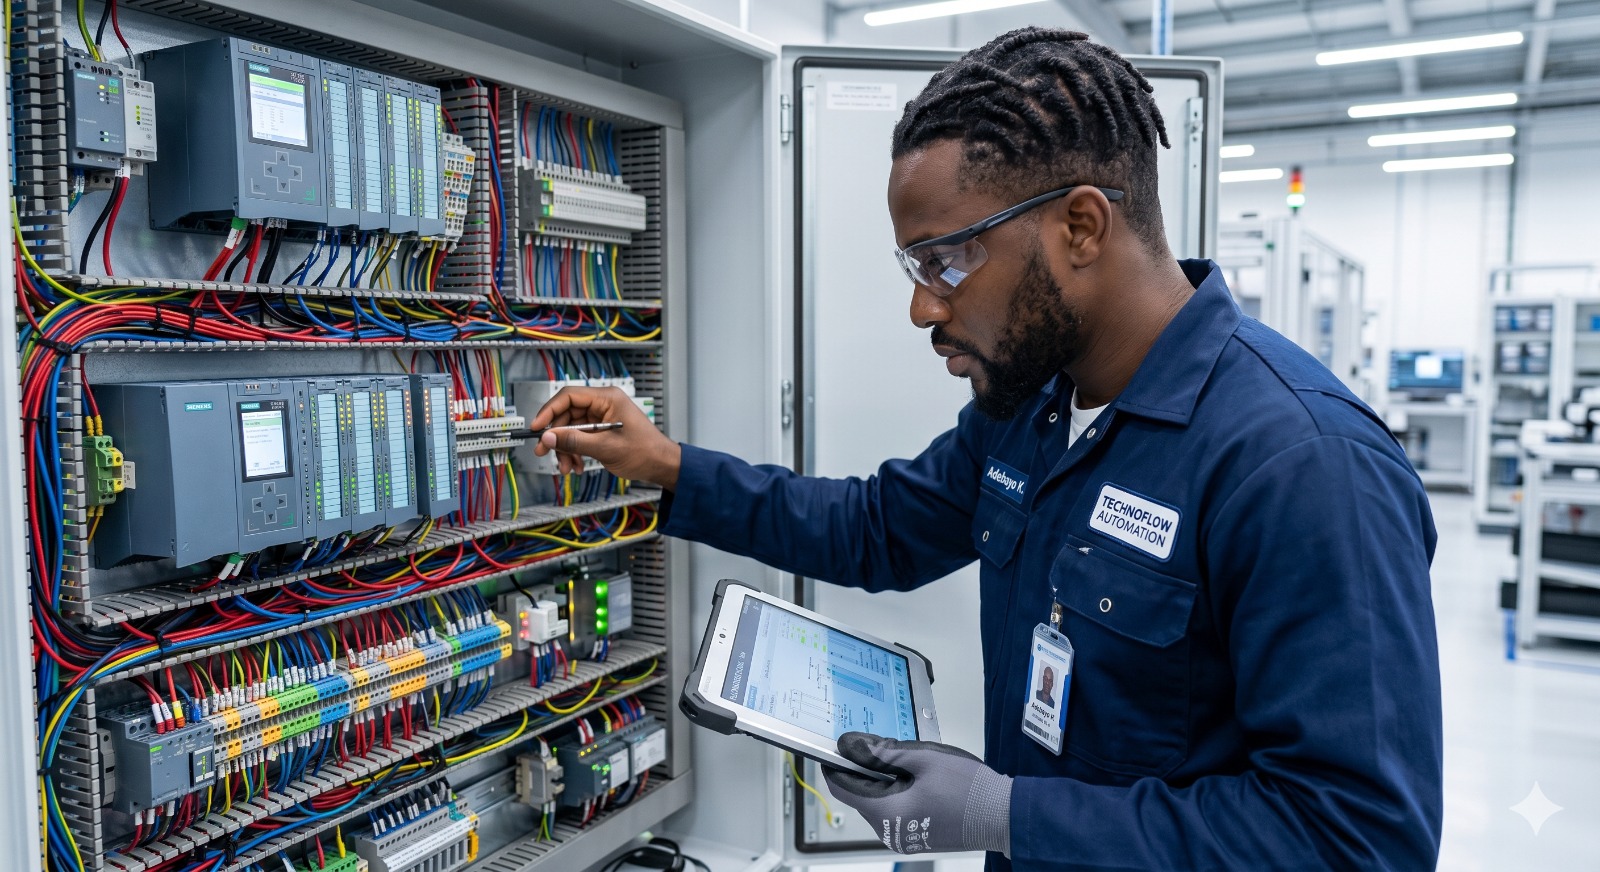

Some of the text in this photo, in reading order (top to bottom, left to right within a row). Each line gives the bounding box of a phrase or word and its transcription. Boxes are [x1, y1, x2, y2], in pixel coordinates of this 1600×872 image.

[986, 466, 1025, 495] Adebayo K.
[1096, 510, 1166, 548] AUTOMATION
[1102, 495, 1173, 533] TECHNOFLOW
